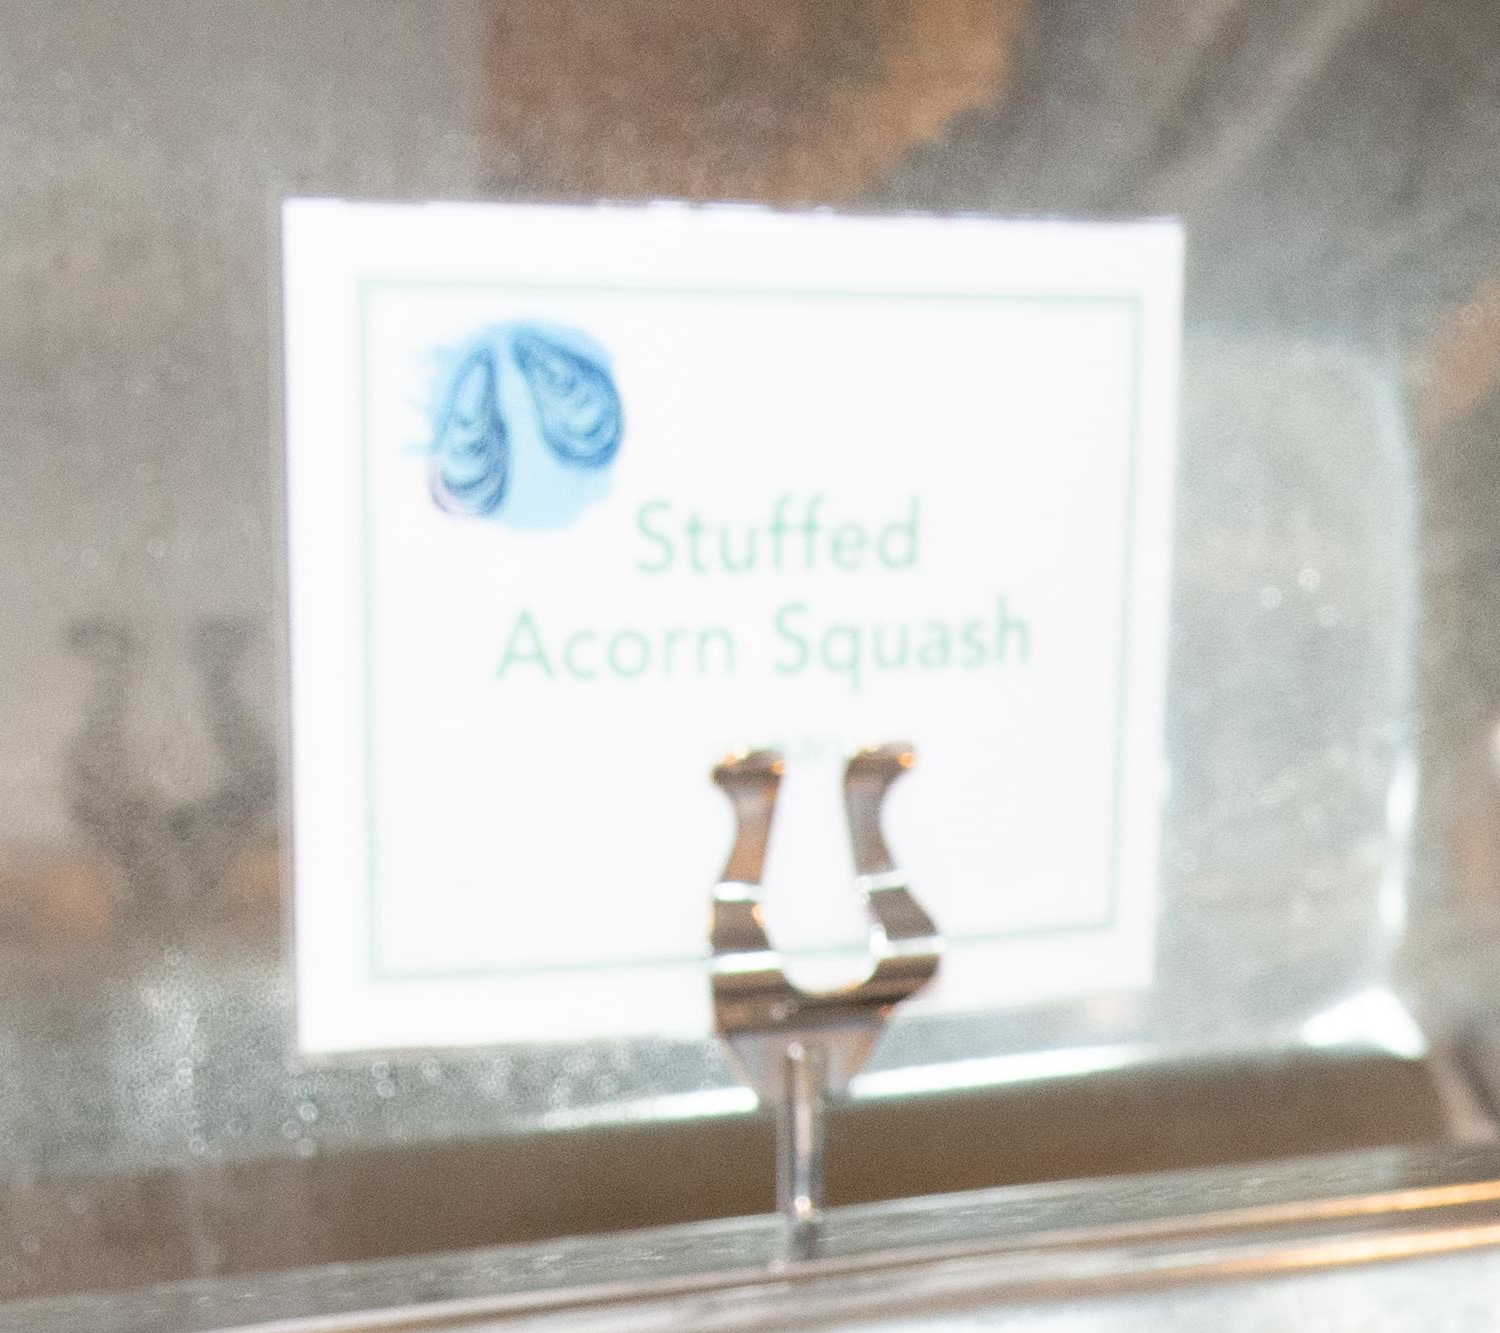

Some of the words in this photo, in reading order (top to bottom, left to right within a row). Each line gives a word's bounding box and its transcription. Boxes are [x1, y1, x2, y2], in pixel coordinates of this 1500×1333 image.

[636, 493, 920, 573] Stuffed
[495, 608, 736, 680] Acorn
[773, 595, 1031, 690] Squash
